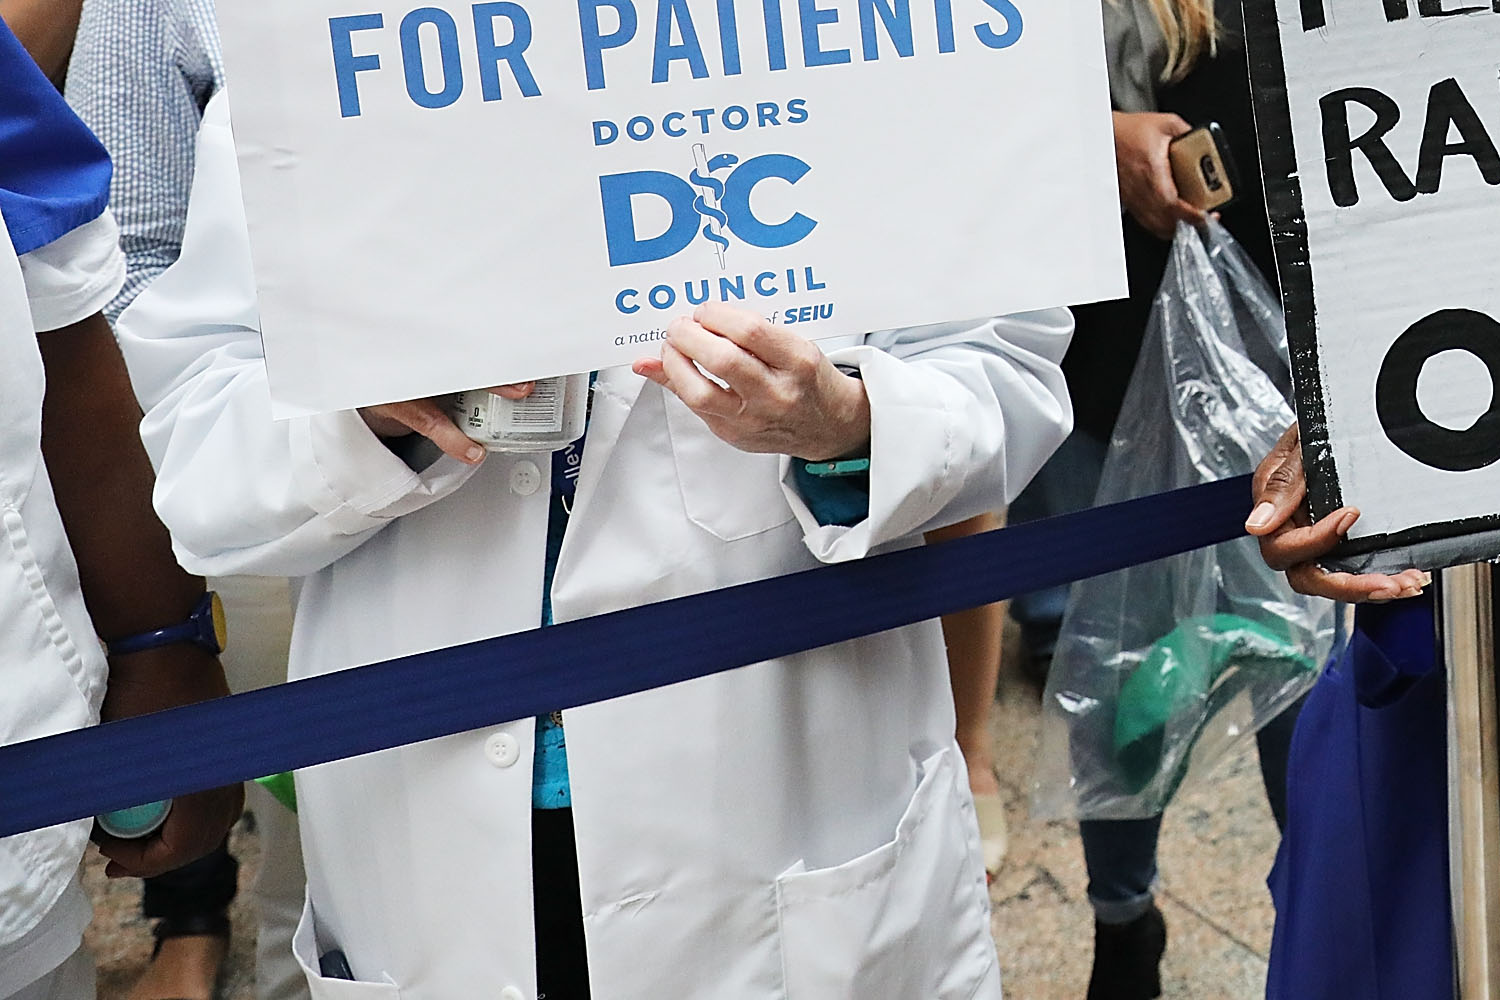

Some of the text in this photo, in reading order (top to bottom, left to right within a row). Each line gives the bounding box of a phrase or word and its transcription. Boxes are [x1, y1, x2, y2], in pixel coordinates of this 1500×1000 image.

[328, 1, 542, 118] FOR
[592, 99, 809, 146] DOCTORS
[615, 266, 826, 314] COUNCIL
[614, 334, 625, 346] a
[783, 303, 834, 325] SEIU
